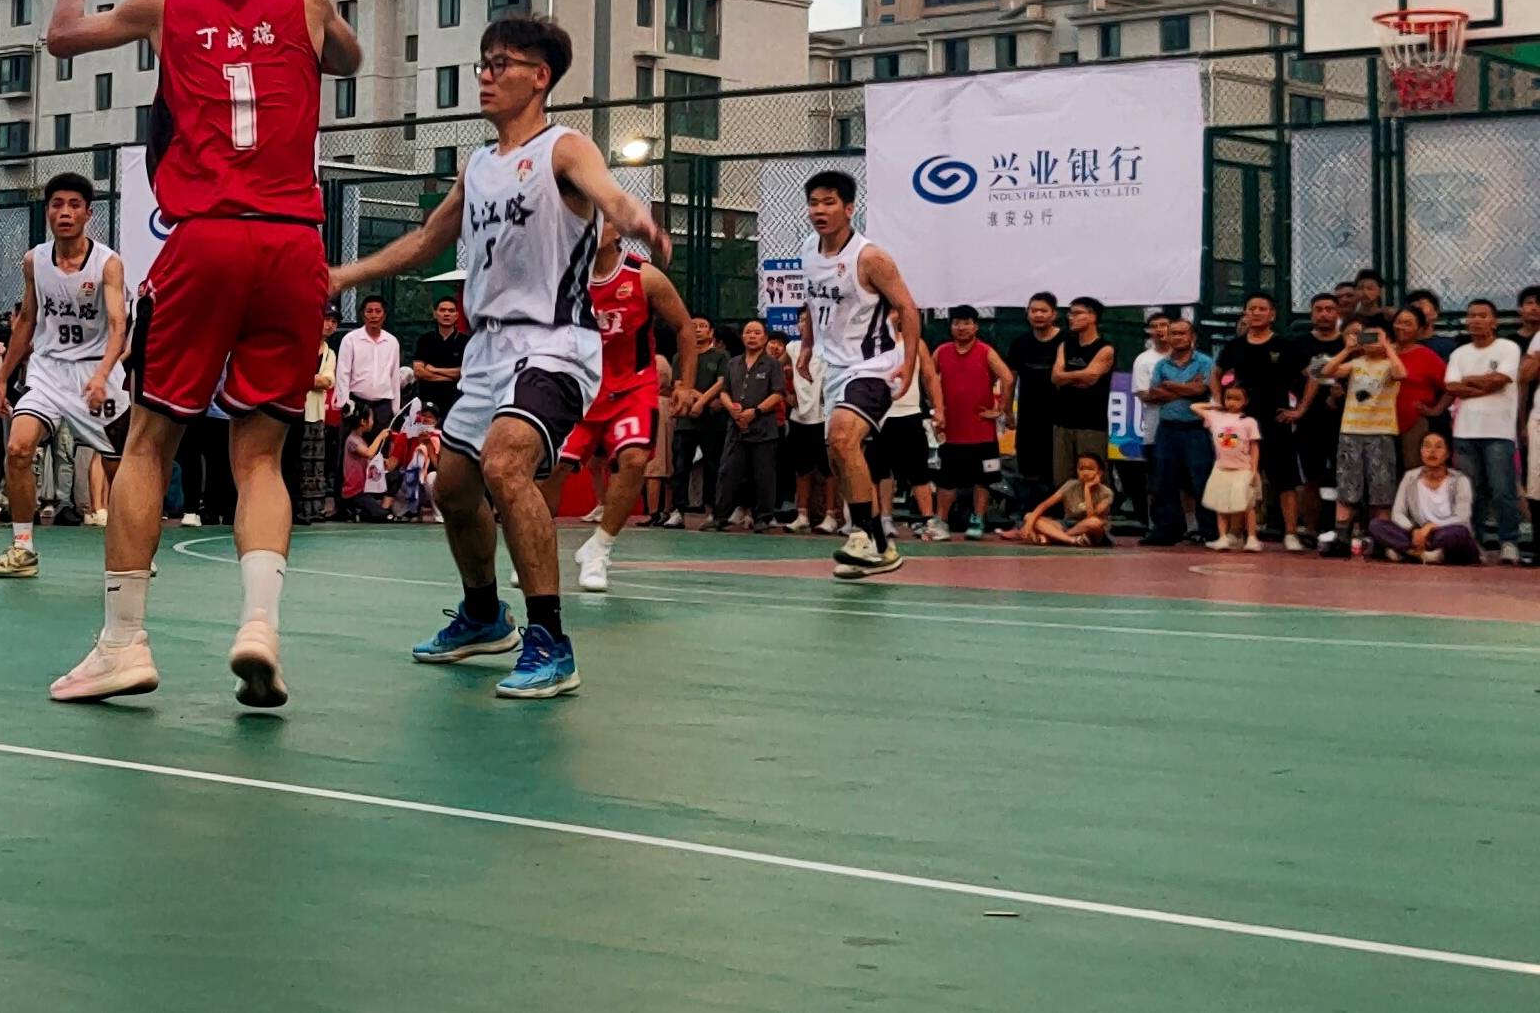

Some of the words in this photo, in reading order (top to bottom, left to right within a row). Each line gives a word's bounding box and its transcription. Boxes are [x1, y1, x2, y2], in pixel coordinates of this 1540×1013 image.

[222, 62, 257, 151] 1
[988, 146, 1143, 187] 兴业银行
[988, 190, 1055, 202] INDUSTRIAL
[1059, 189, 1090, 199] BANK
[43, 295, 99, 320] 长江路
[59, 324, 84, 345] 99
